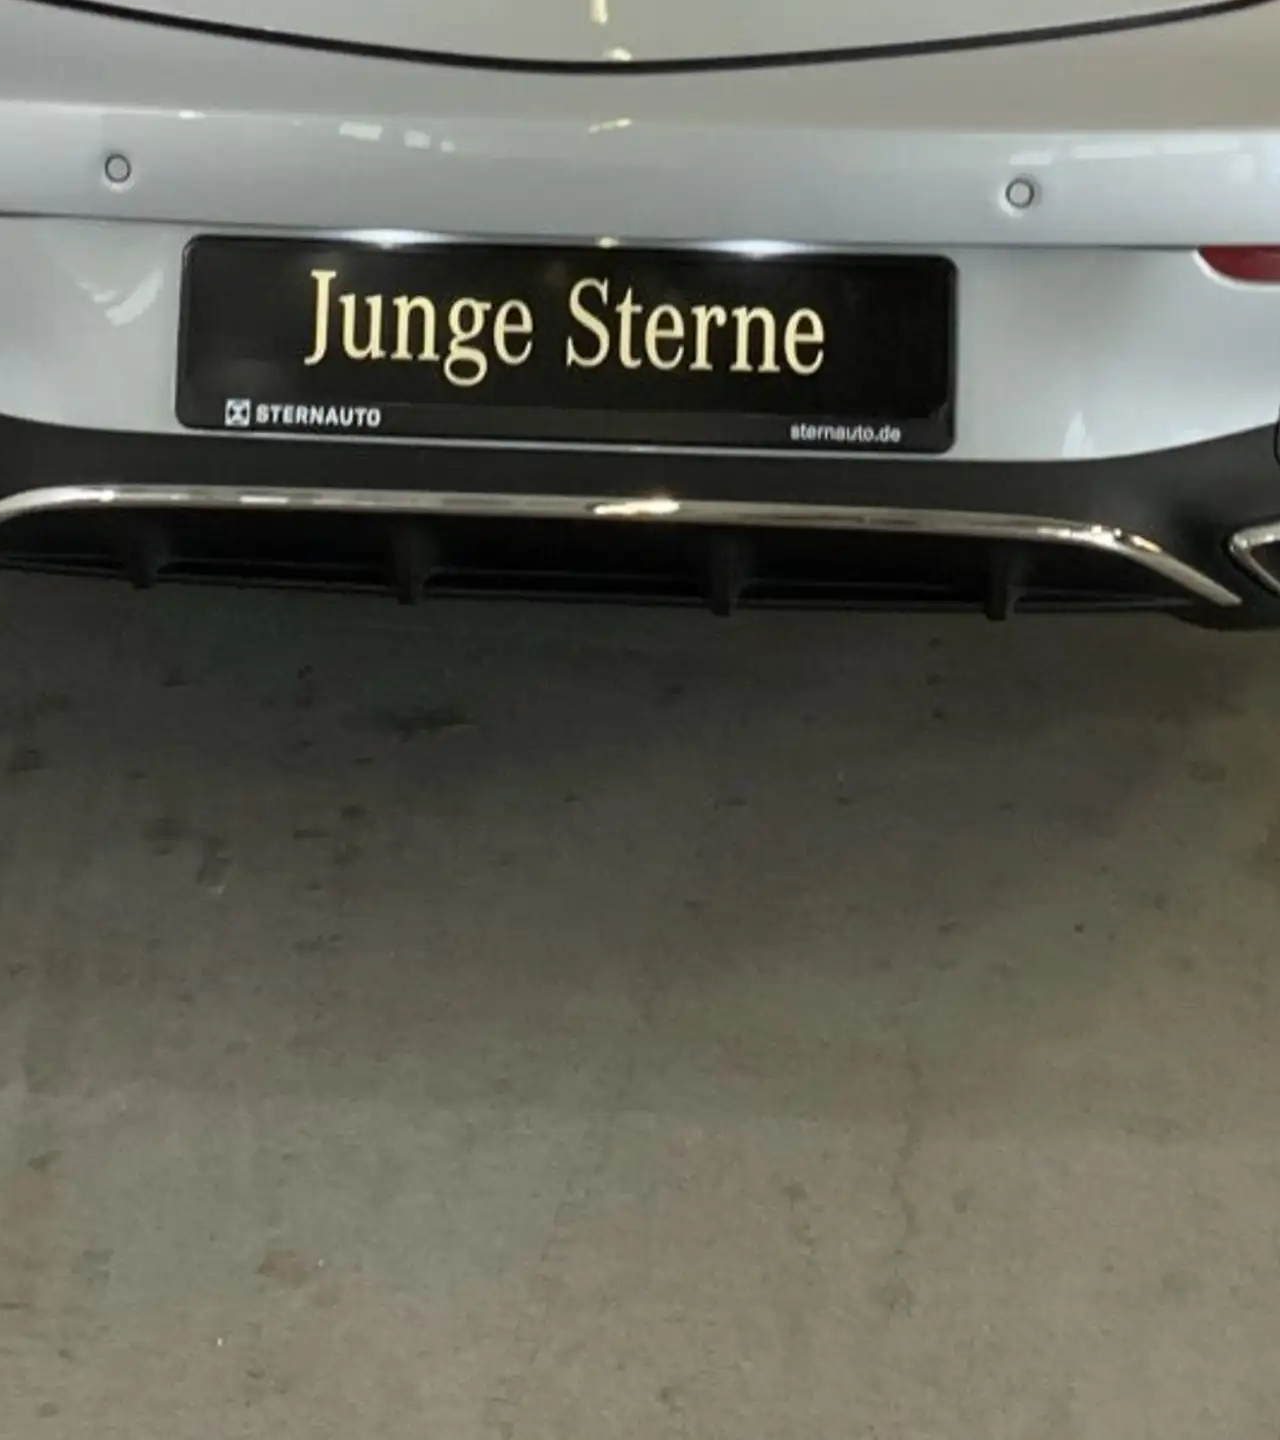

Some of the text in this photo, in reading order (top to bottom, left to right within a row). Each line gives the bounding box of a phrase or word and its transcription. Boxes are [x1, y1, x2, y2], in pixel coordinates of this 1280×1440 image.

[304, 269, 825, 387] Junge Sterne
[255, 403, 382, 428] STERNAUTO
[790, 422, 902, 443] sternauto.de
